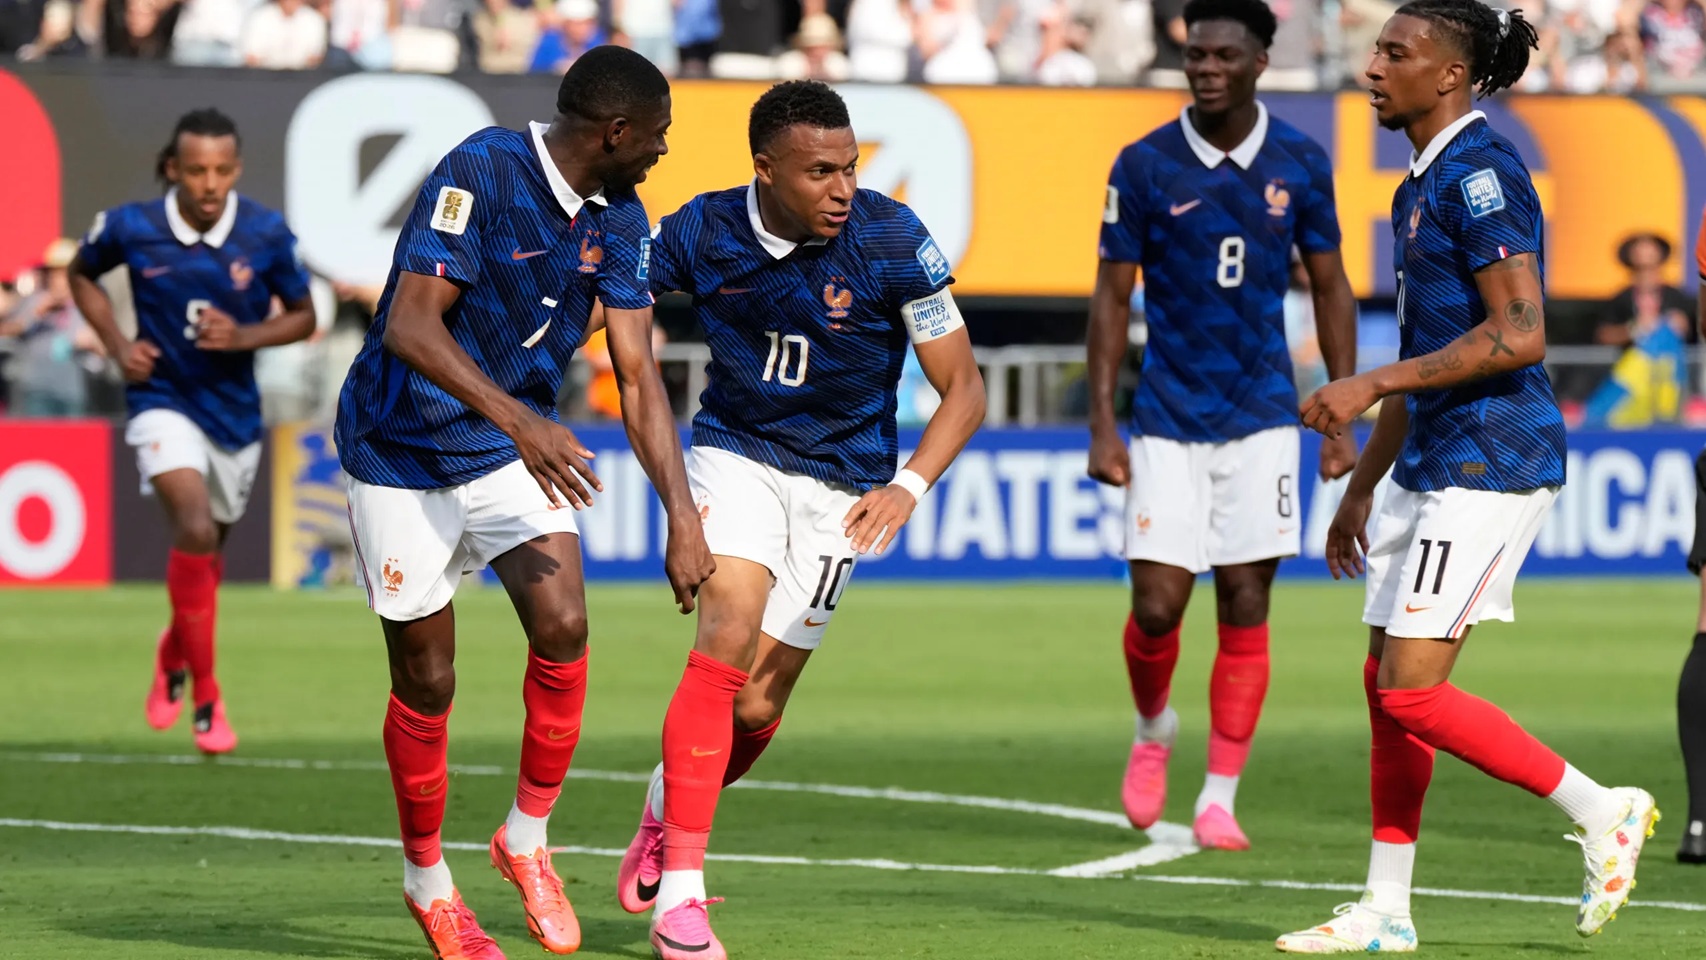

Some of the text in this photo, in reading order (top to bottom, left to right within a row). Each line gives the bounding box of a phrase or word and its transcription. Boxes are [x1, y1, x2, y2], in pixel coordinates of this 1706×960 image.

[1469, 183, 1494, 198] UNITES
[1217, 236, 1245, 288] 8
[521, 296, 558, 348] 7
[911, 295, 944, 311] FOOTBALL
[913, 302, 946, 322] UNITES
[915, 311, 951, 332] the World
[762, 330, 809, 387] 10
[1277, 474, 1291, 518] 8
[809, 554, 853, 611] 10
[1413, 538, 1452, 595] 11
